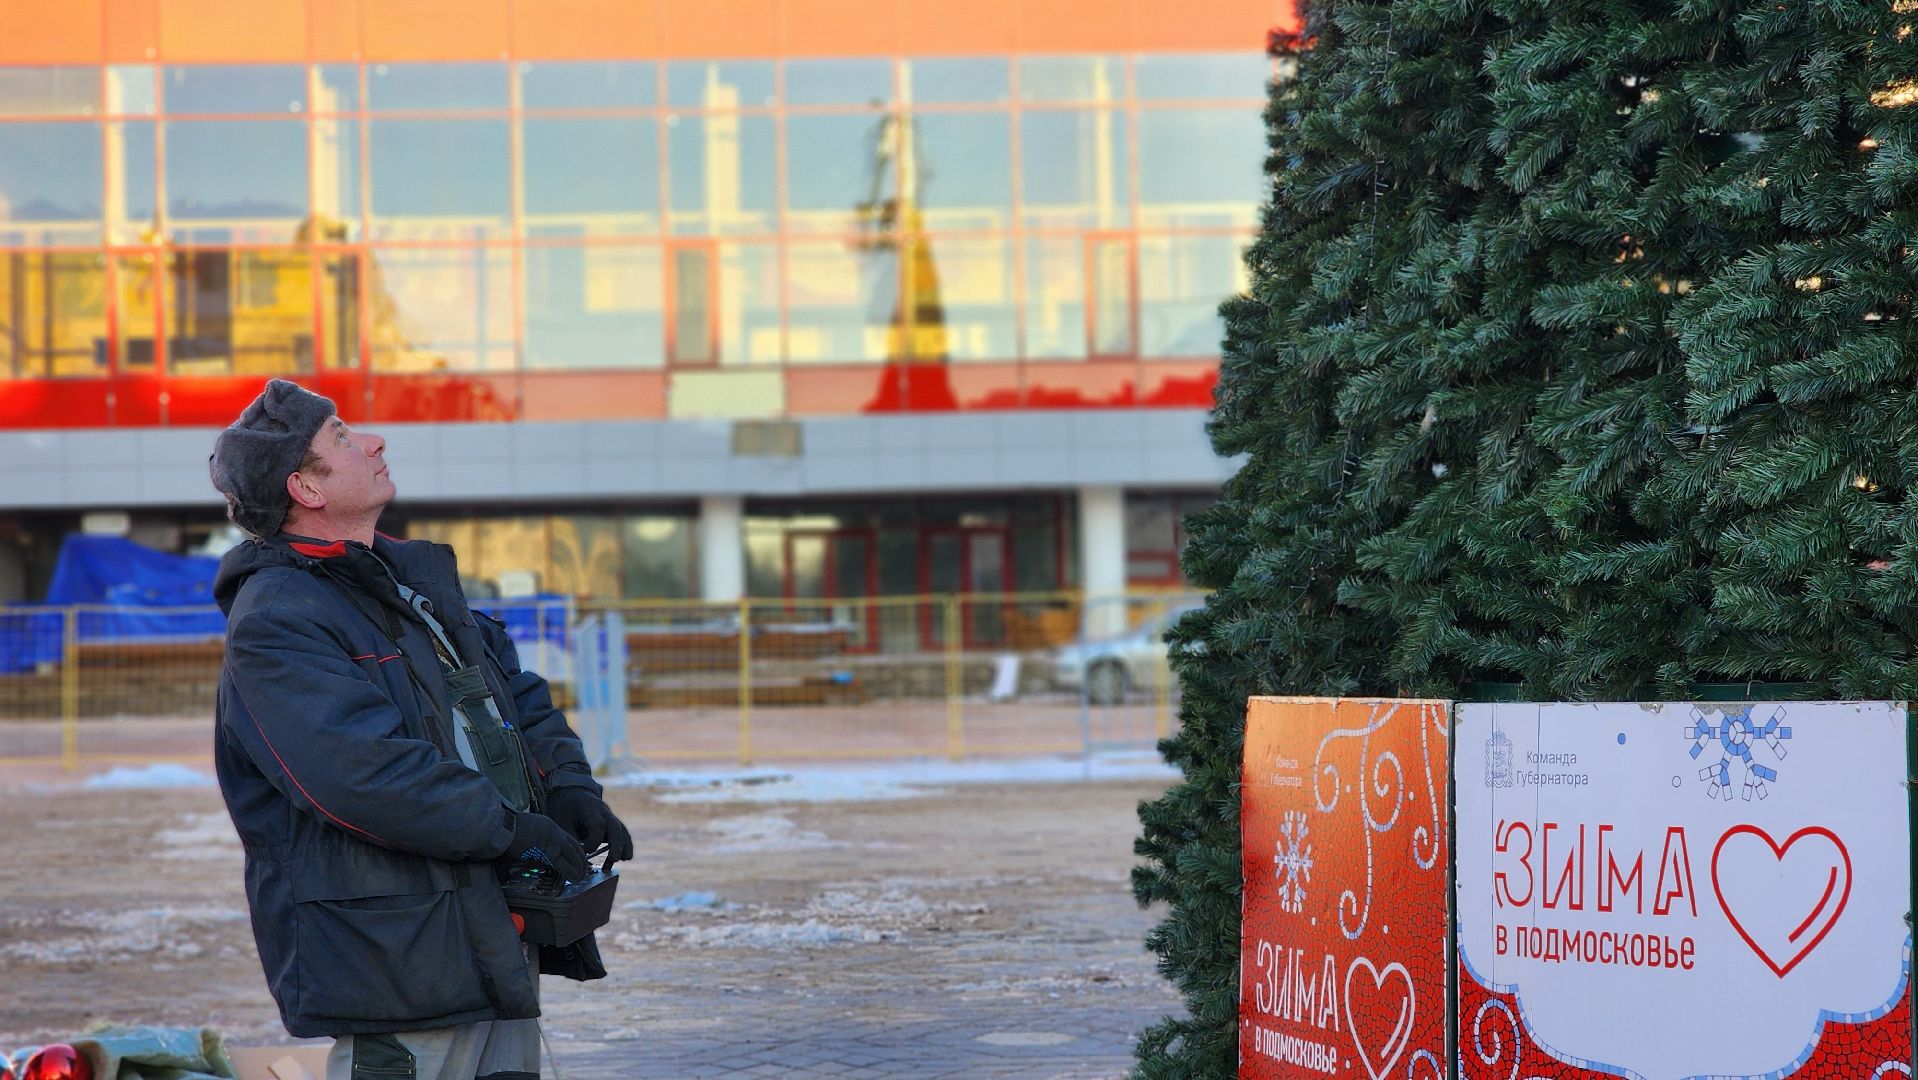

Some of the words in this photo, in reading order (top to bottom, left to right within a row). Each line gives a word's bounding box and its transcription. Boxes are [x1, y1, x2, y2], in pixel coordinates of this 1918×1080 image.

[1516, 770, 1589, 788] Губернатора
[1526, 751, 1577, 767] Команда
[1494, 818, 1698, 917] ЗИМА
[1256, 938, 1339, 1032] ЗИМА
